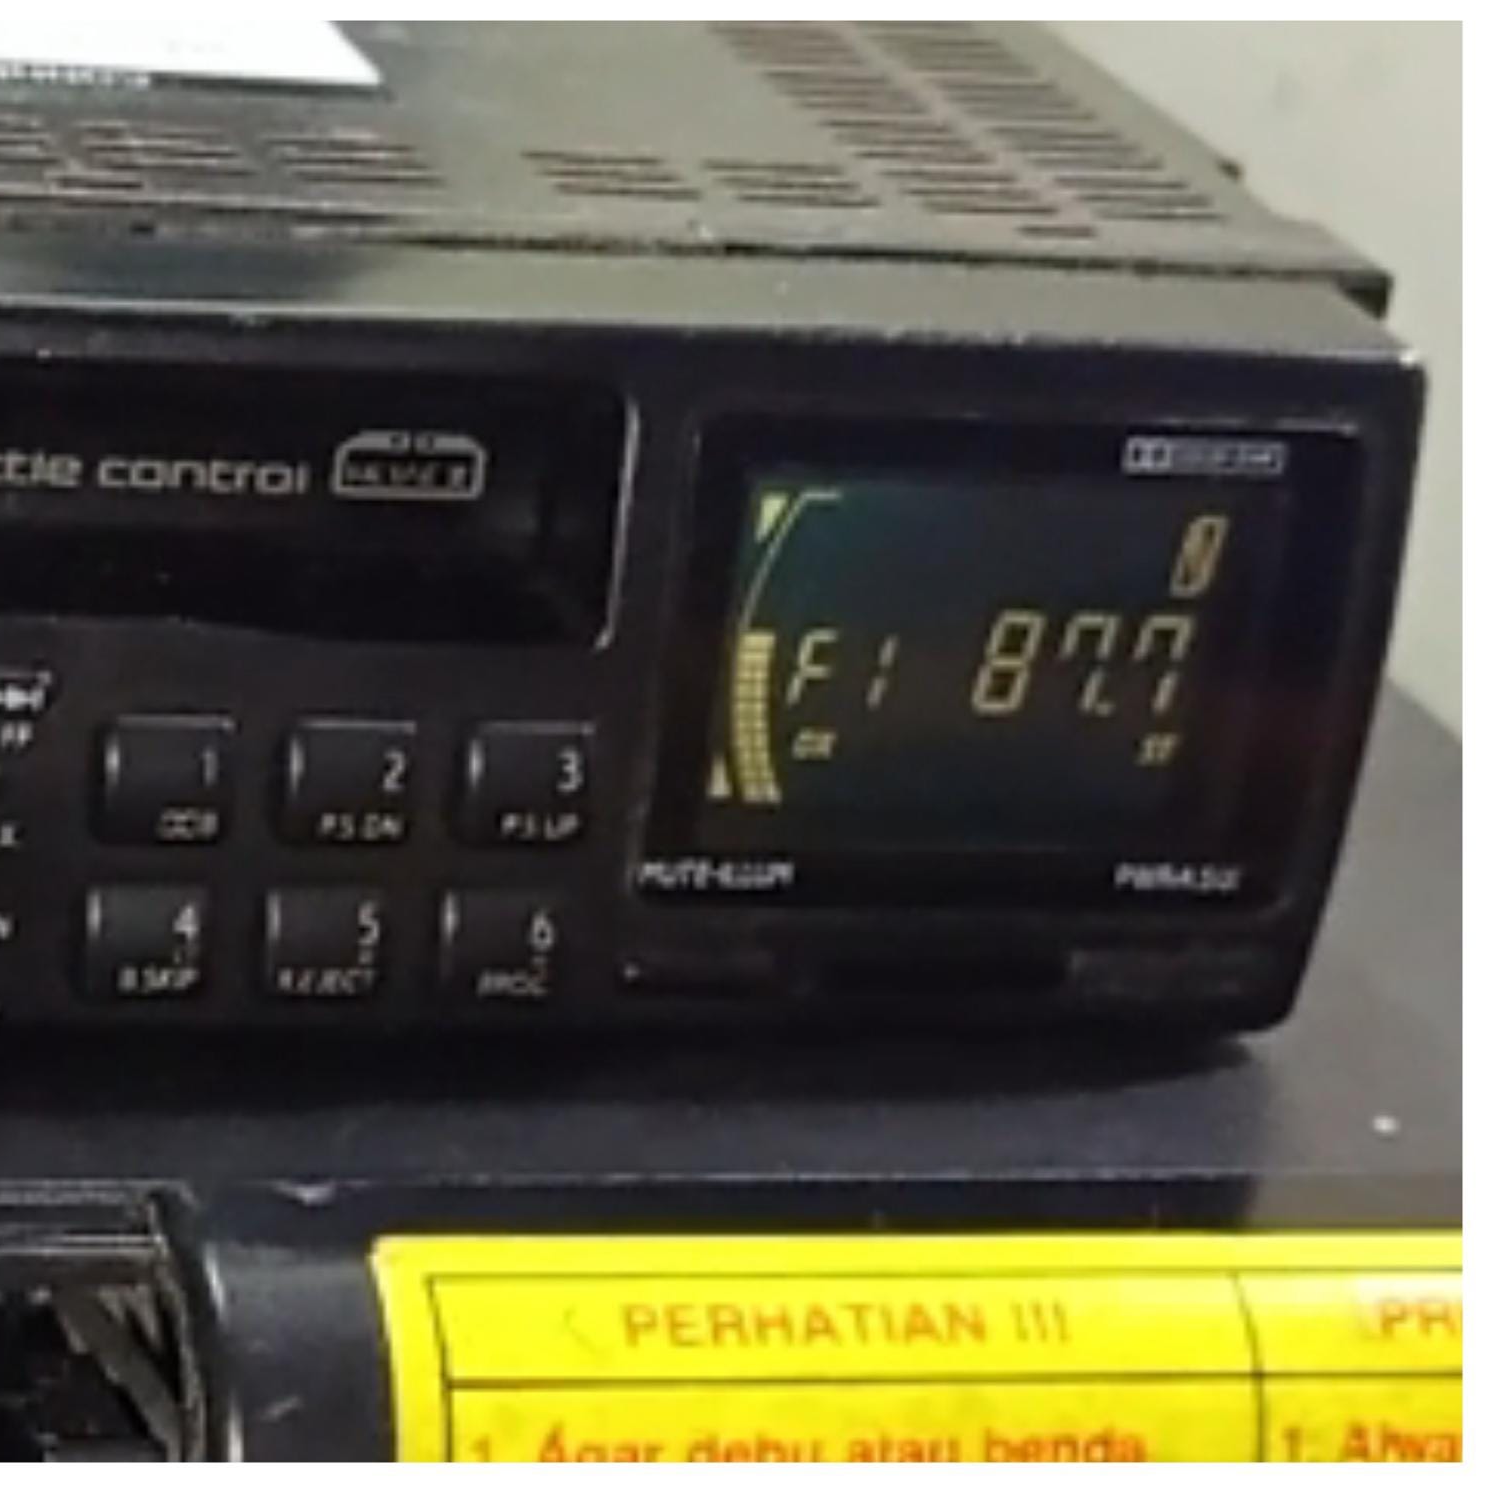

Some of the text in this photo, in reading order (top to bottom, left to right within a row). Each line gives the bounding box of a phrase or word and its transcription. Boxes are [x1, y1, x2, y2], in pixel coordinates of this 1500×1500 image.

[98, 452, 305, 495] control
[202, 747, 218, 786] 1
[382, 750, 406, 792] 2
[557, 749, 583, 793] 3
[173, 904, 198, 940] 4
[356, 903, 380, 947] 5
[528, 911, 554, 950] 6
[621, 1301, 989, 1348] PERHATIAN
